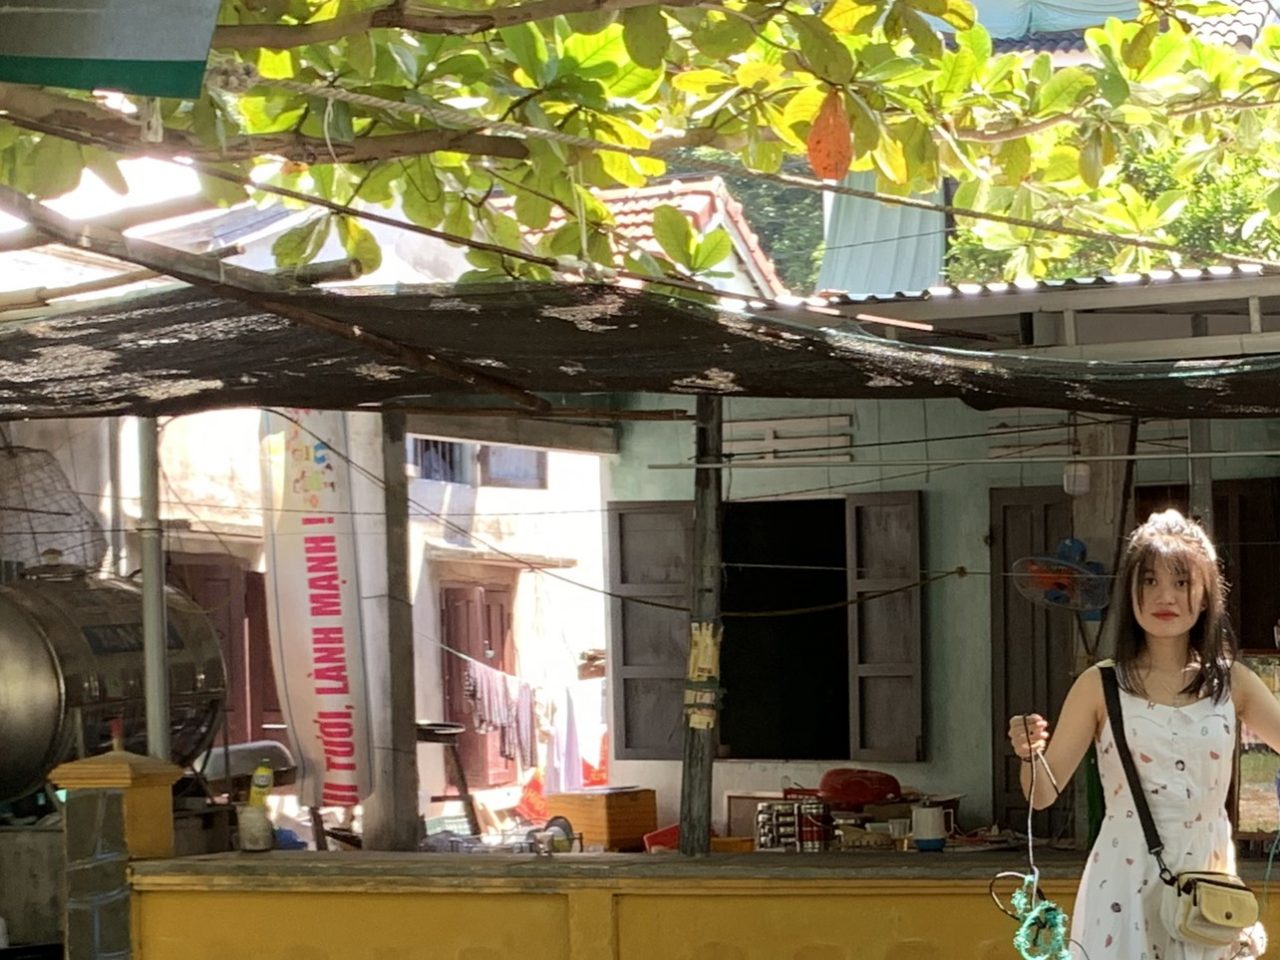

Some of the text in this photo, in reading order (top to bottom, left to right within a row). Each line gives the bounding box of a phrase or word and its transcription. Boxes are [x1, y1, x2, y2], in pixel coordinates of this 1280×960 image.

[304, 536, 347, 617] MẠNH
[307, 627, 350, 695] LÀNH
[322, 783, 359, 806] UI
